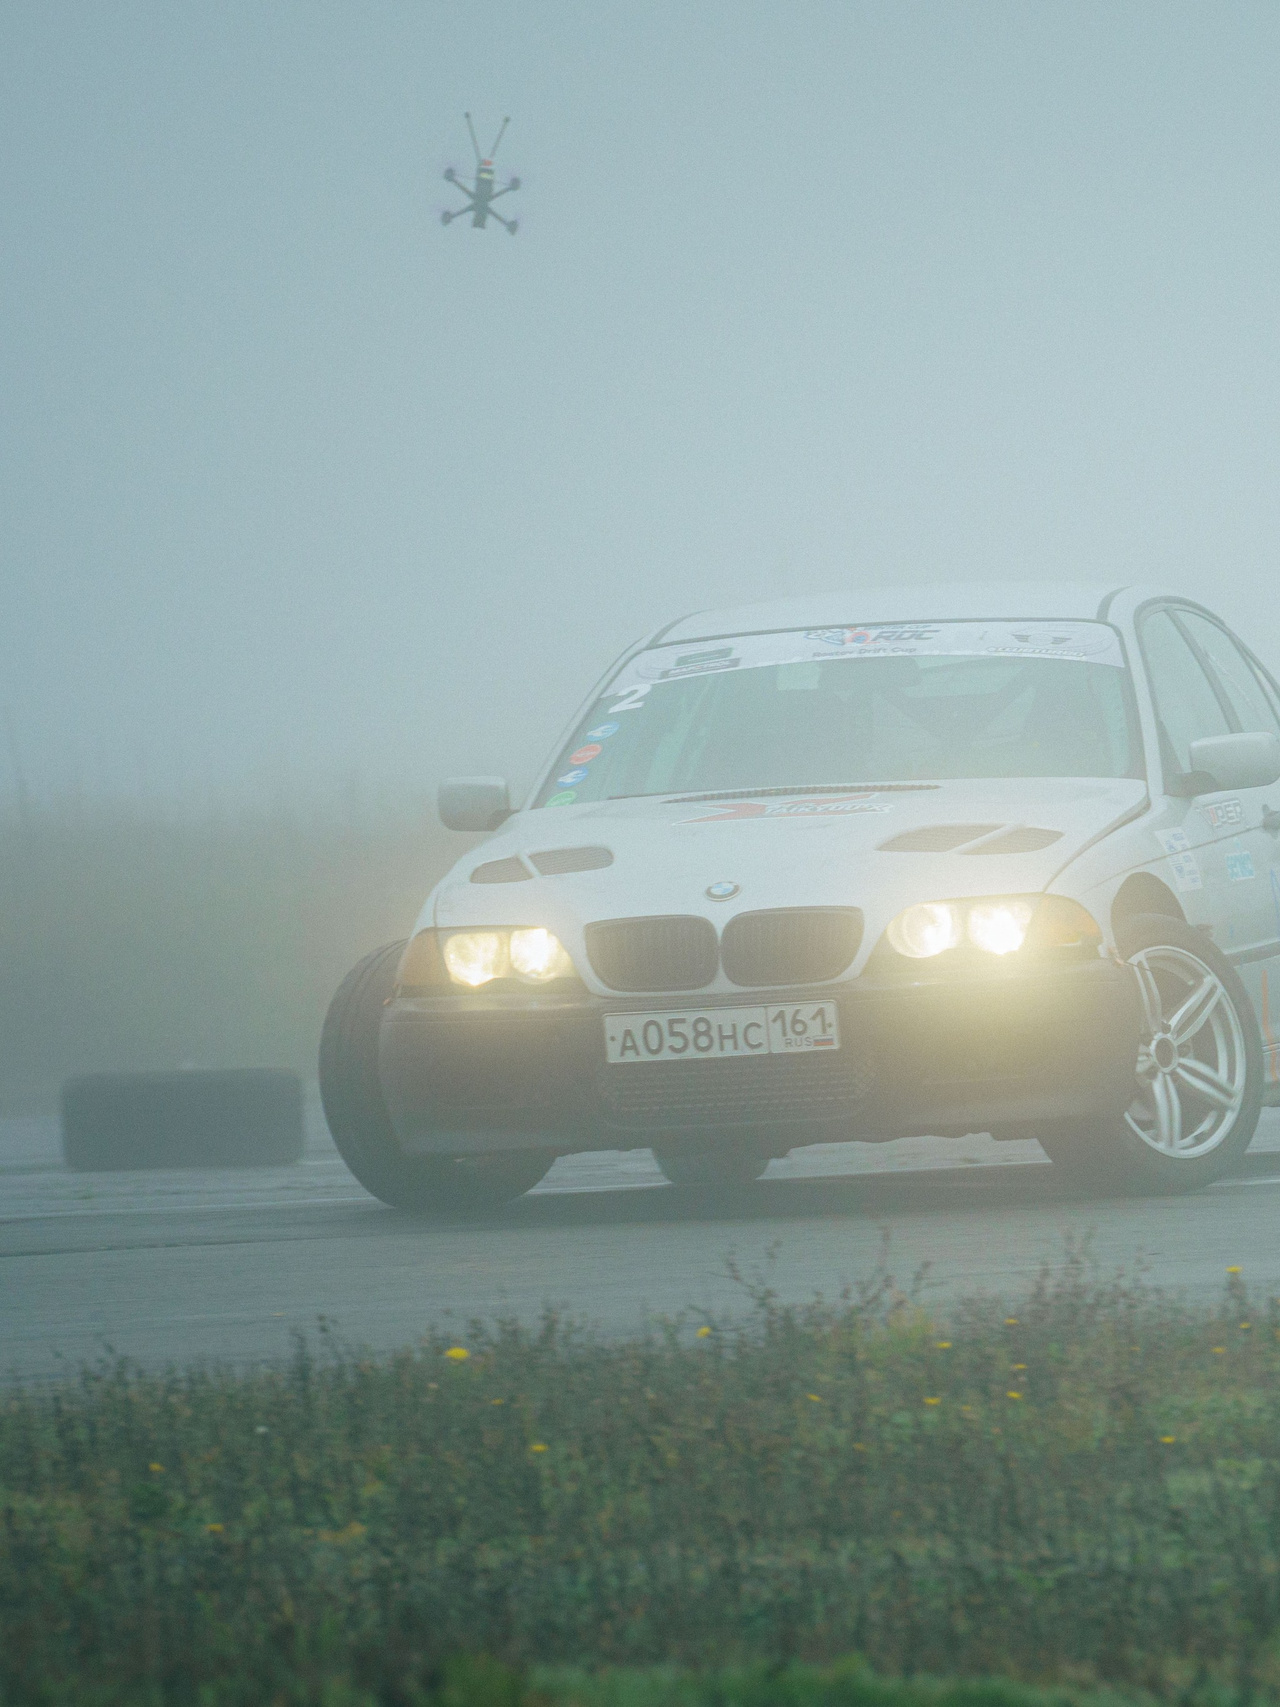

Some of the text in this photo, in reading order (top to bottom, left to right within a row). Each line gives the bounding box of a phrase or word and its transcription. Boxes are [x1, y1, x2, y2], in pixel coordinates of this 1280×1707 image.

[872, 629, 941, 641] RDC
[859, 647, 887, 655] Drift
[891, 646, 917, 654] Cup
[607, 683, 652, 714] 2
[771, 1006, 828, 1038] 161
[784, 1035, 813, 1049] RUS
